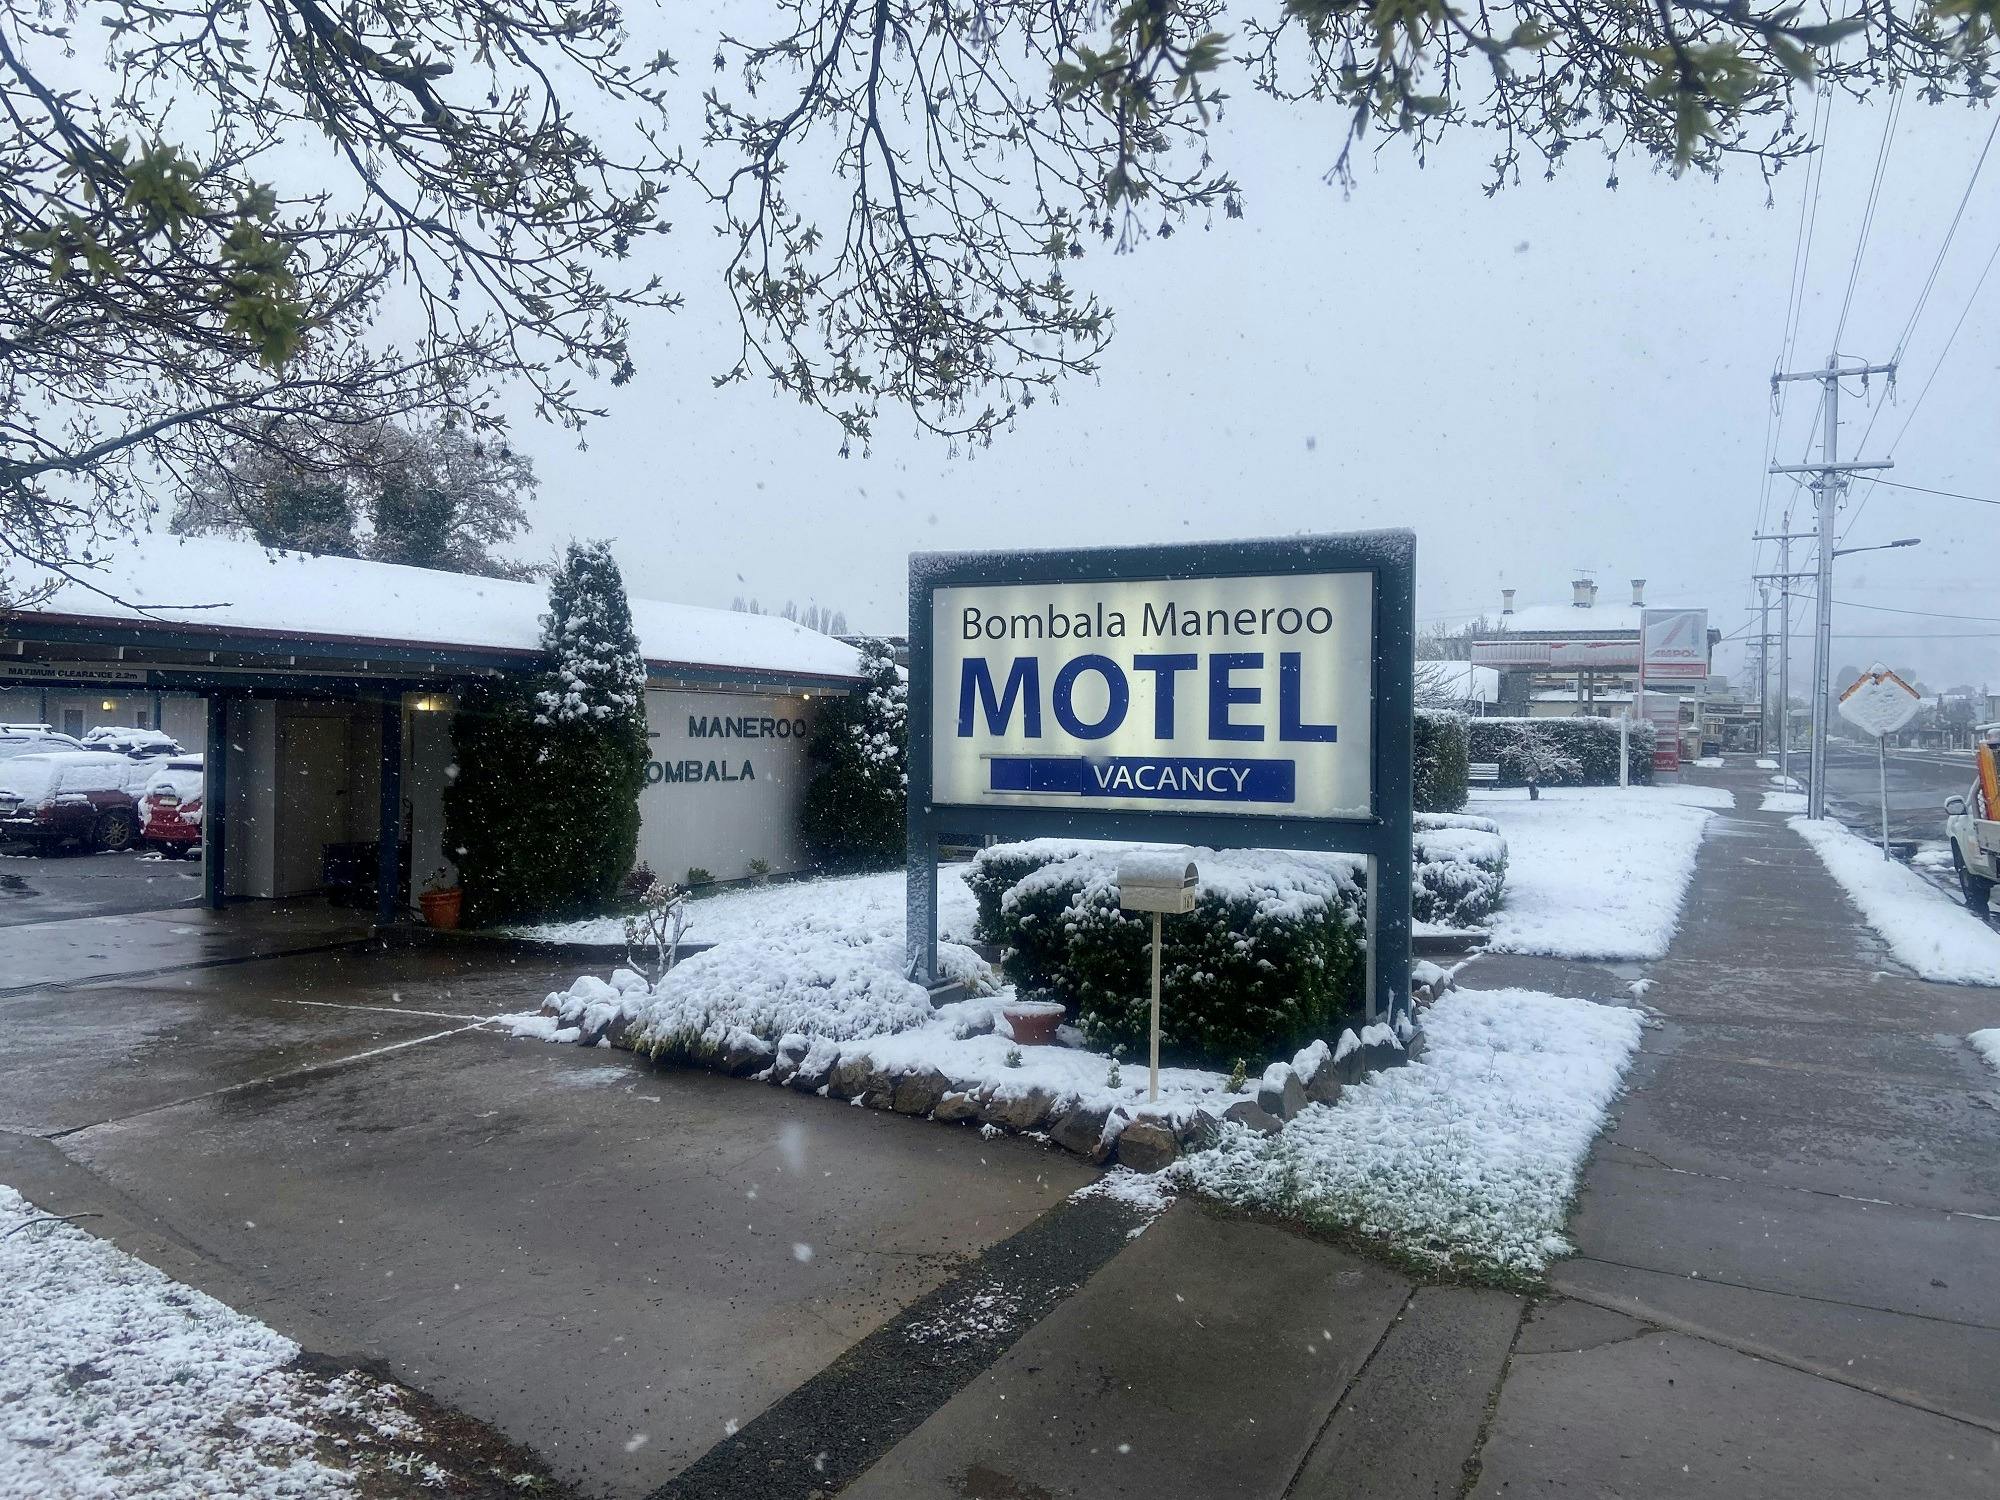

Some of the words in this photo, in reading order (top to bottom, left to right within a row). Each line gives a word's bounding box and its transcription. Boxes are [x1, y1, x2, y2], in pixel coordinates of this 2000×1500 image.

[963, 602, 1126, 640] Bombala
[1142, 602, 1333, 637] Maneroo
[8, 667, 55, 677] MAXIMUM
[58, 670, 113, 679] CLEARANCE
[115, 672, 138, 680] 2.2m
[957, 652, 1338, 743] MOTEL
[688, 715, 807, 738] MANEROO
[645, 759, 756, 784] OMBALA
[1093, 765, 1251, 793] VACANCY
